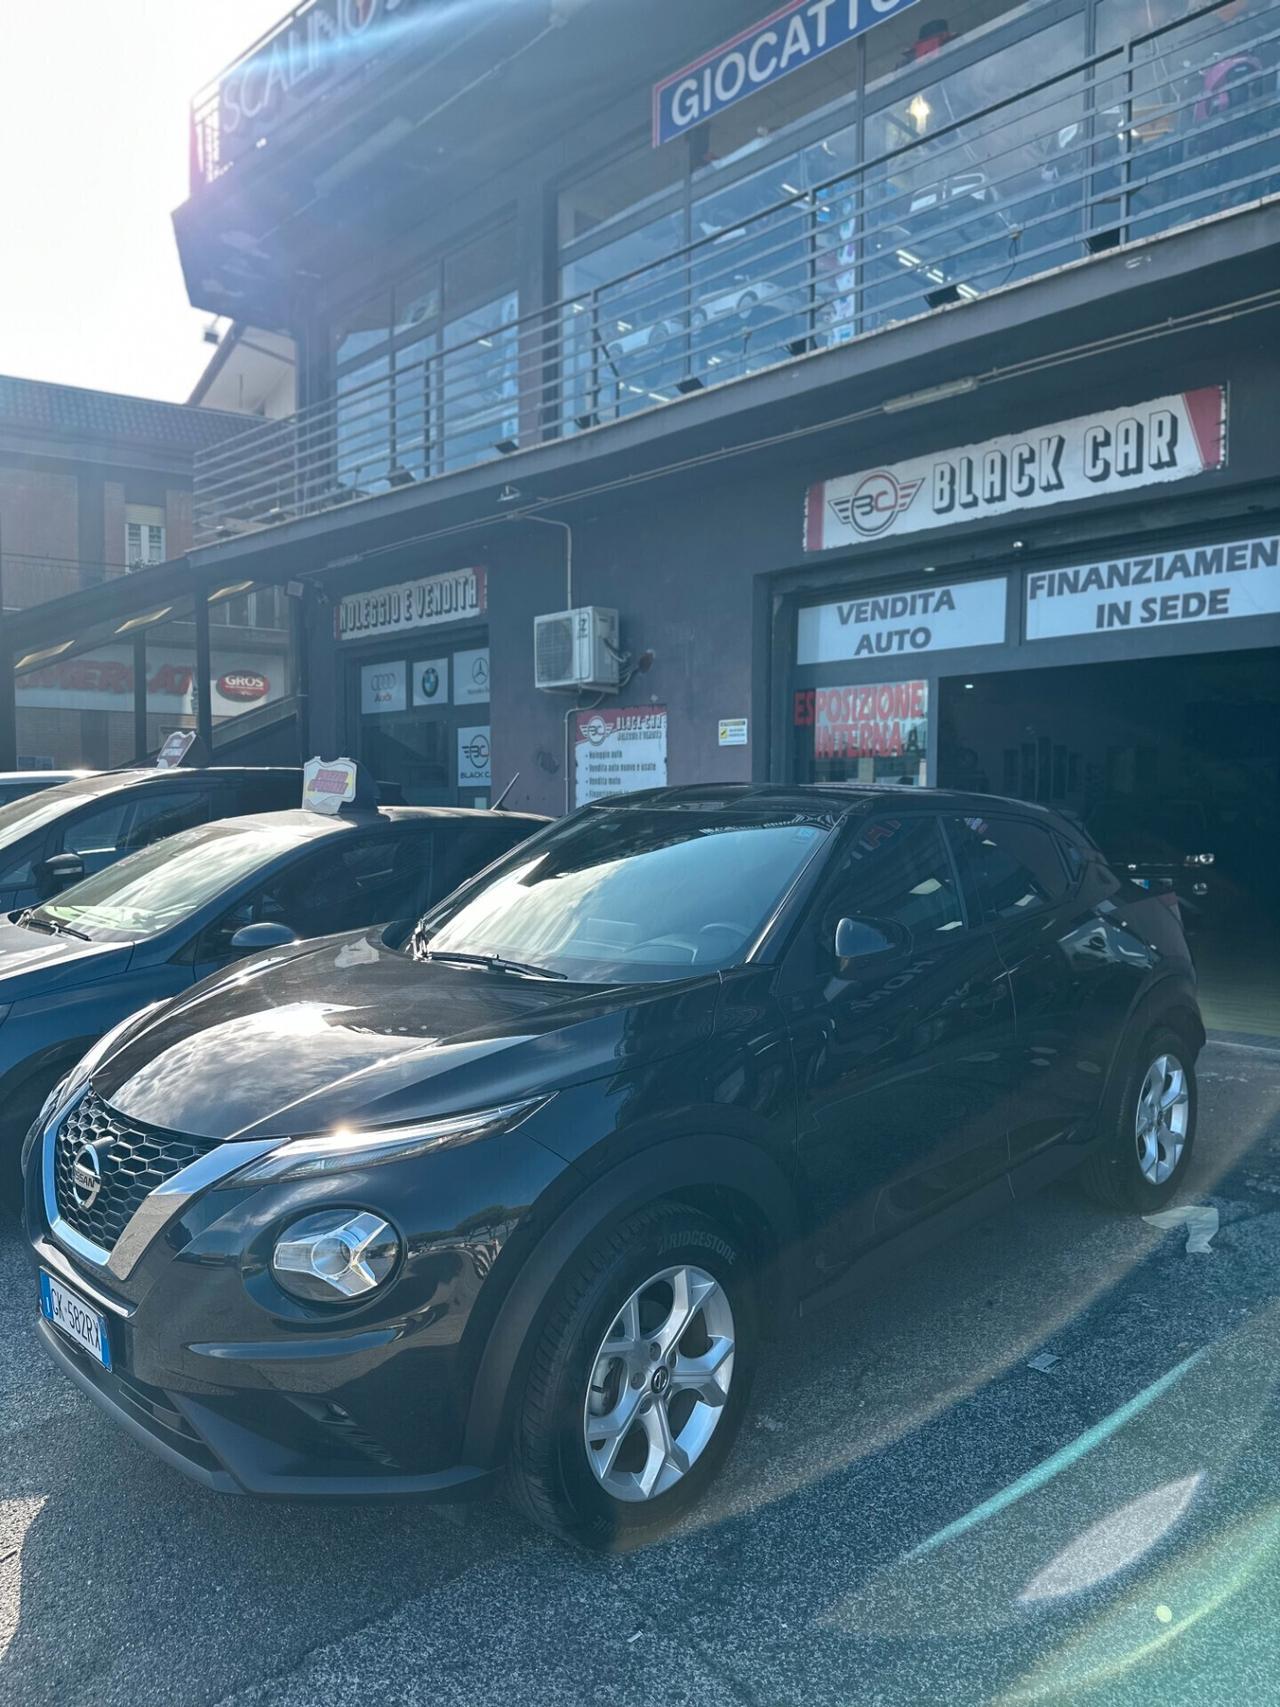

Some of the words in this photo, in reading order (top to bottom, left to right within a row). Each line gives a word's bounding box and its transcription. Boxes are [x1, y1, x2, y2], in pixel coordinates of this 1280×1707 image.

[223, 0, 400, 133] SCALINO
[671, 0, 903, 126] GIOCATT
[932, 435, 1066, 515] BLACK
[1083, 409, 1179, 483] CAR
[1029, 539, 1279, 599] FINANZIAMEN
[339, 591, 399, 633] NOLEGGIO
[404, 588, 413, 621] E
[416, 573, 478, 619] VENDITA
[837, 589, 956, 626] VENDITA
[1095, 601, 1132, 629] IN
[1139, 588, 1232, 624] SEDE
[854, 626, 932, 656] AUTO
[224, 675, 265, 688] GROS
[374, 691, 393, 703] Audi
[794, 682, 925, 726] ESPOSIZIONE
[815, 721, 904, 758] INTERNA
[460, 771, 483, 779] BLACK
